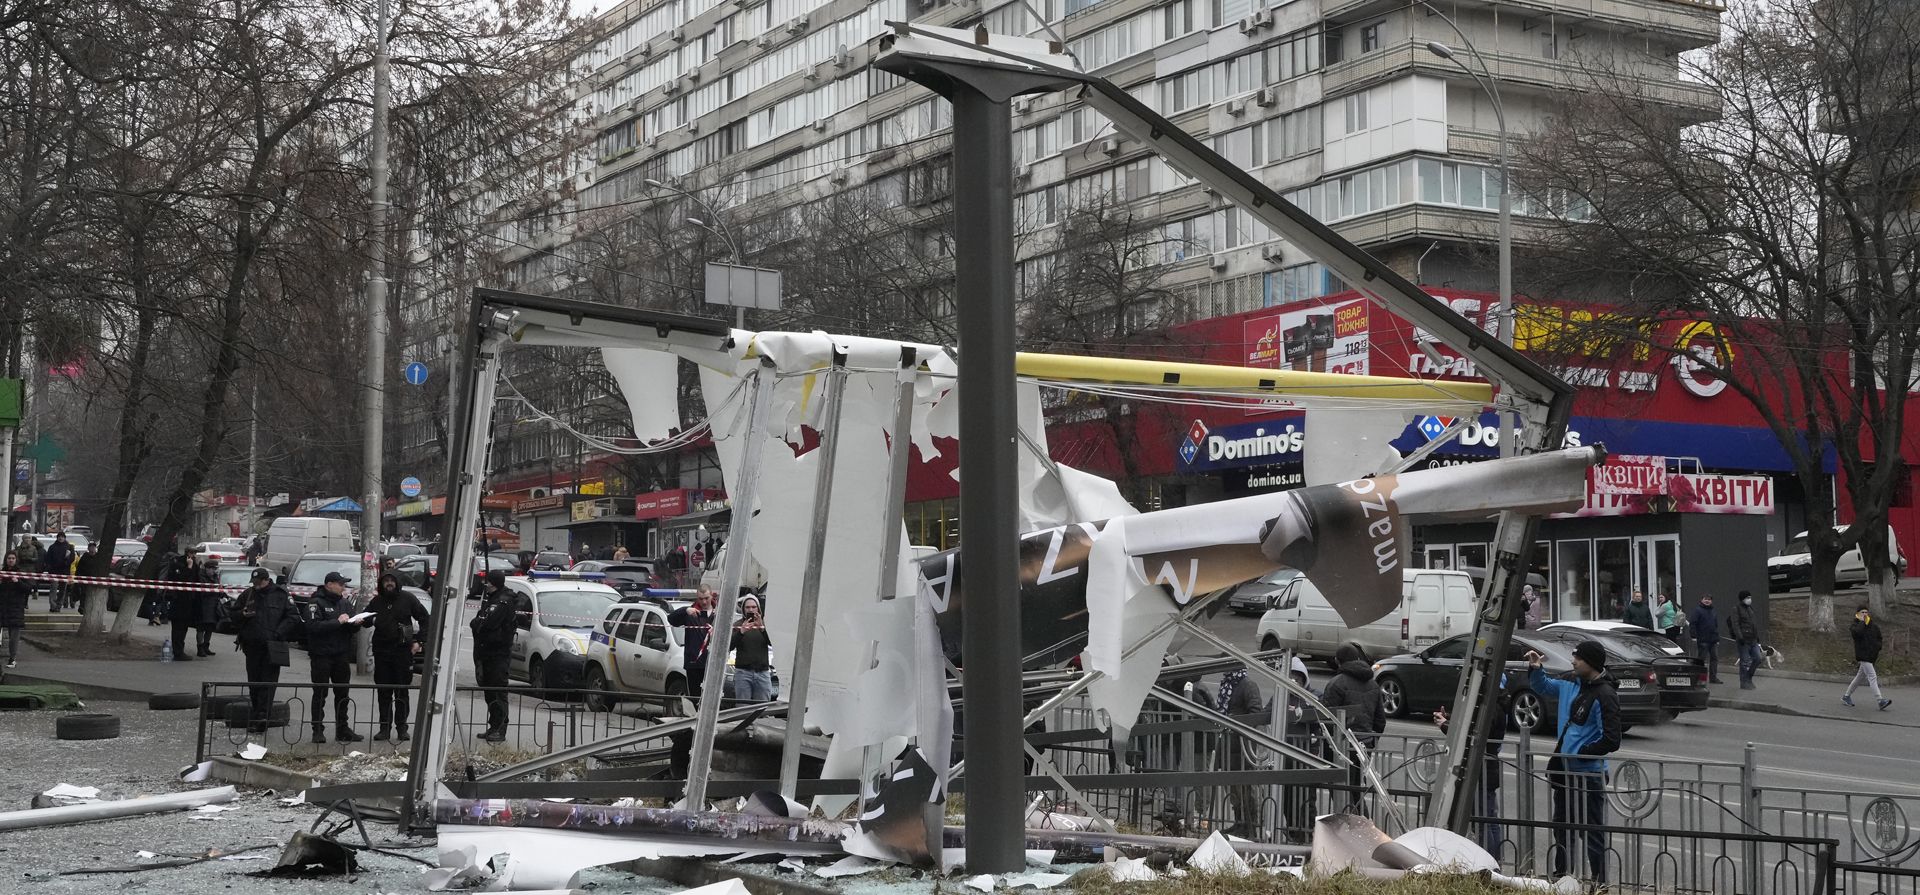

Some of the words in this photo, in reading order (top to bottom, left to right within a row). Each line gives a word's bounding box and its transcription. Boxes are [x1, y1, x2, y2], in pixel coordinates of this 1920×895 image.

[1337, 306, 1362, 321] ТОВАР
[1337, 317, 1369, 334] ТИЖНЯ!
[1249, 348, 1278, 360] ВЕЛМАРТ
[1345, 341, 1360, 357] 118
[1208, 424, 1305, 462] Domino's
[1247, 472, 1302, 488] dominos.ua
[1602, 463, 1658, 490] КВІТИ
[1695, 477, 1770, 508] КВІТИ
